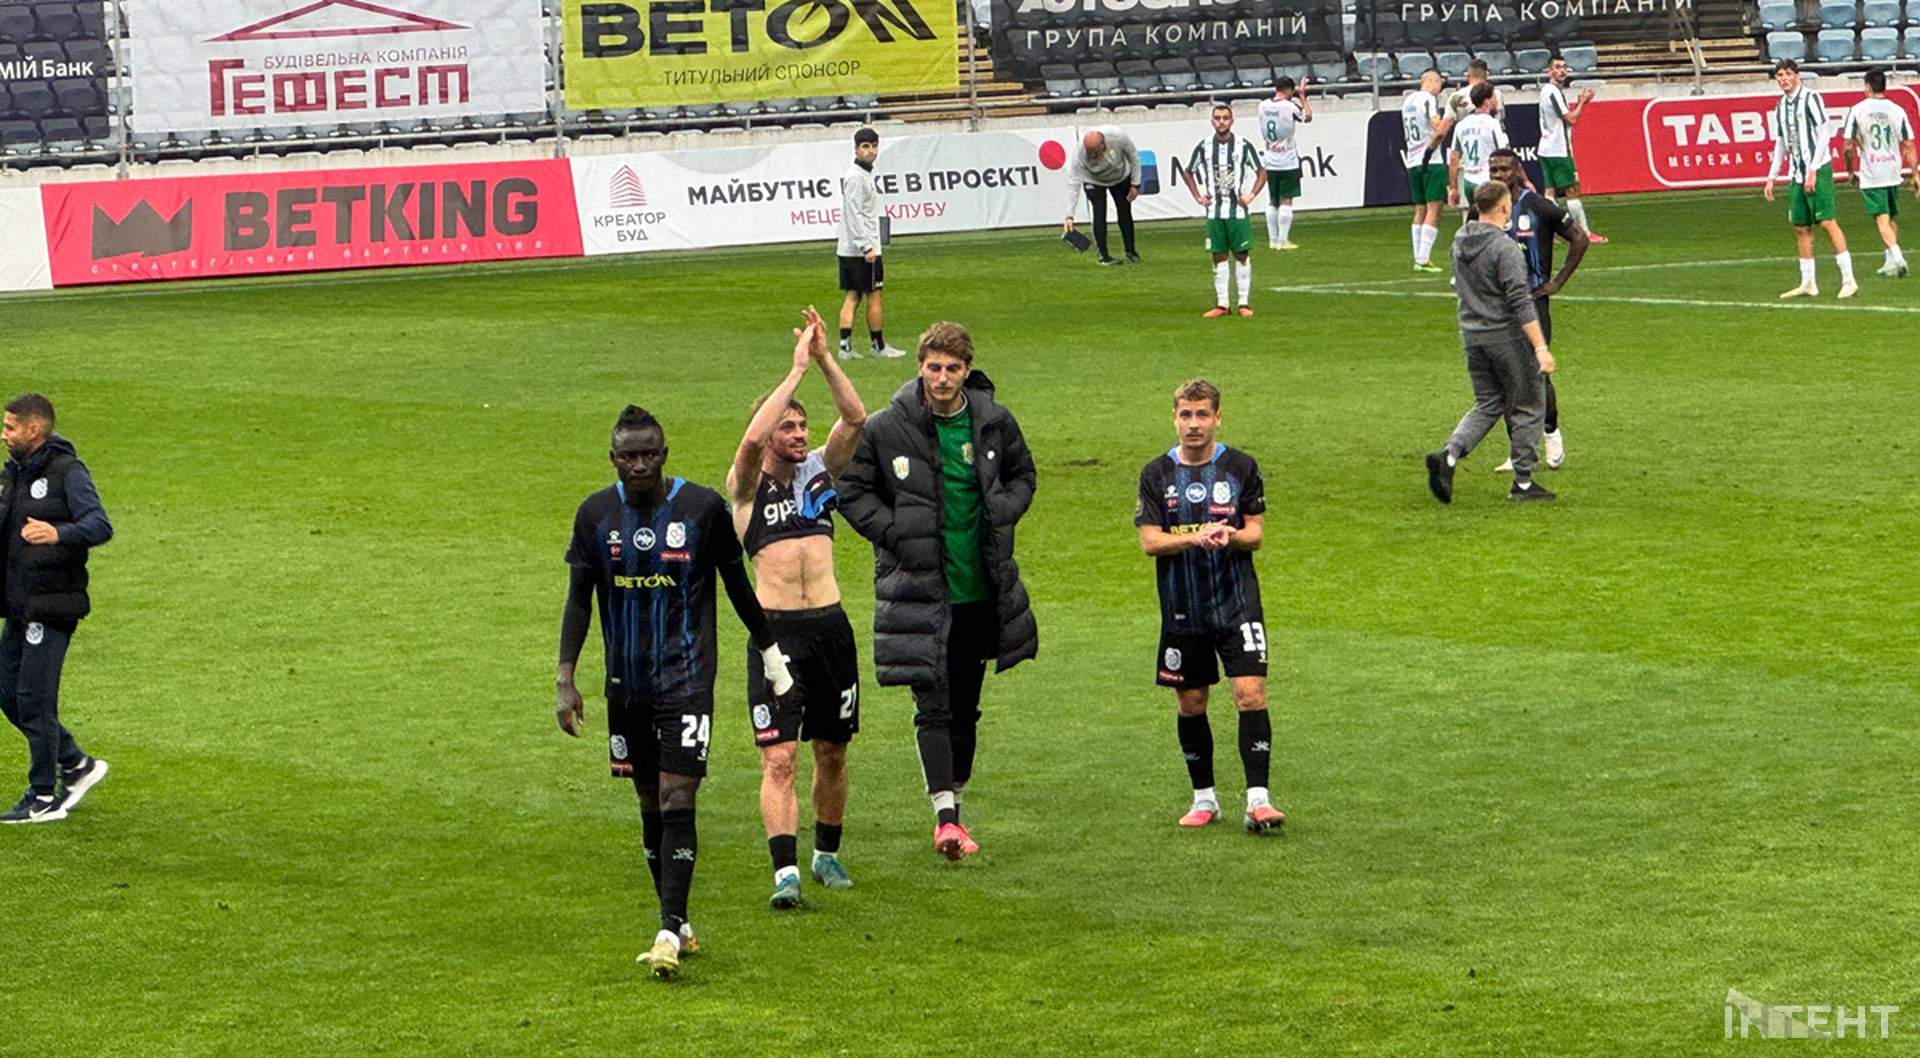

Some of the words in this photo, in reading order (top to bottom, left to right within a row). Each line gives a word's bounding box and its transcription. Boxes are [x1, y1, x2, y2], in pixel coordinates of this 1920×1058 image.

[1402, 3, 1502, 22] ГРУПА
[1026, 29, 1128, 49] ГРУПА
[1146, 12, 1307, 45] КОМПАНІЙ
[42, 60, 94, 77] Банк
[264, 53, 371, 69] БУДІВЕЛЬНА
[376, 46, 468, 62] КОМПАНІЯ
[664, 63, 770, 86] ТИТУЛЬНИЙ
[775, 60, 861, 80] СПОНСОР
[1267, 120, 1278, 142] 8
[1870, 124, 1892, 150] 31
[1464, 140, 1480, 166] 14
[1668, 152, 1744, 168] МЕРЕЖА
[688, 178, 833, 206] МАЙБУТНЄ
[905, 173, 923, 193] В
[929, 166, 1039, 191] ПРОЄКТІ
[224, 178, 538, 250] BETKING
[593, 211, 666, 228] КРЕАТОР
[791, 208, 842, 226] МЕЦЕ
[884, 202, 947, 220] КЛУБУ
[617, 231, 648, 242] БУД
[1170, 523, 1200, 535] BET
[613, 573, 677, 589] BETON
[1240, 621, 1267, 652] 13
[680, 714, 711, 748] 24
